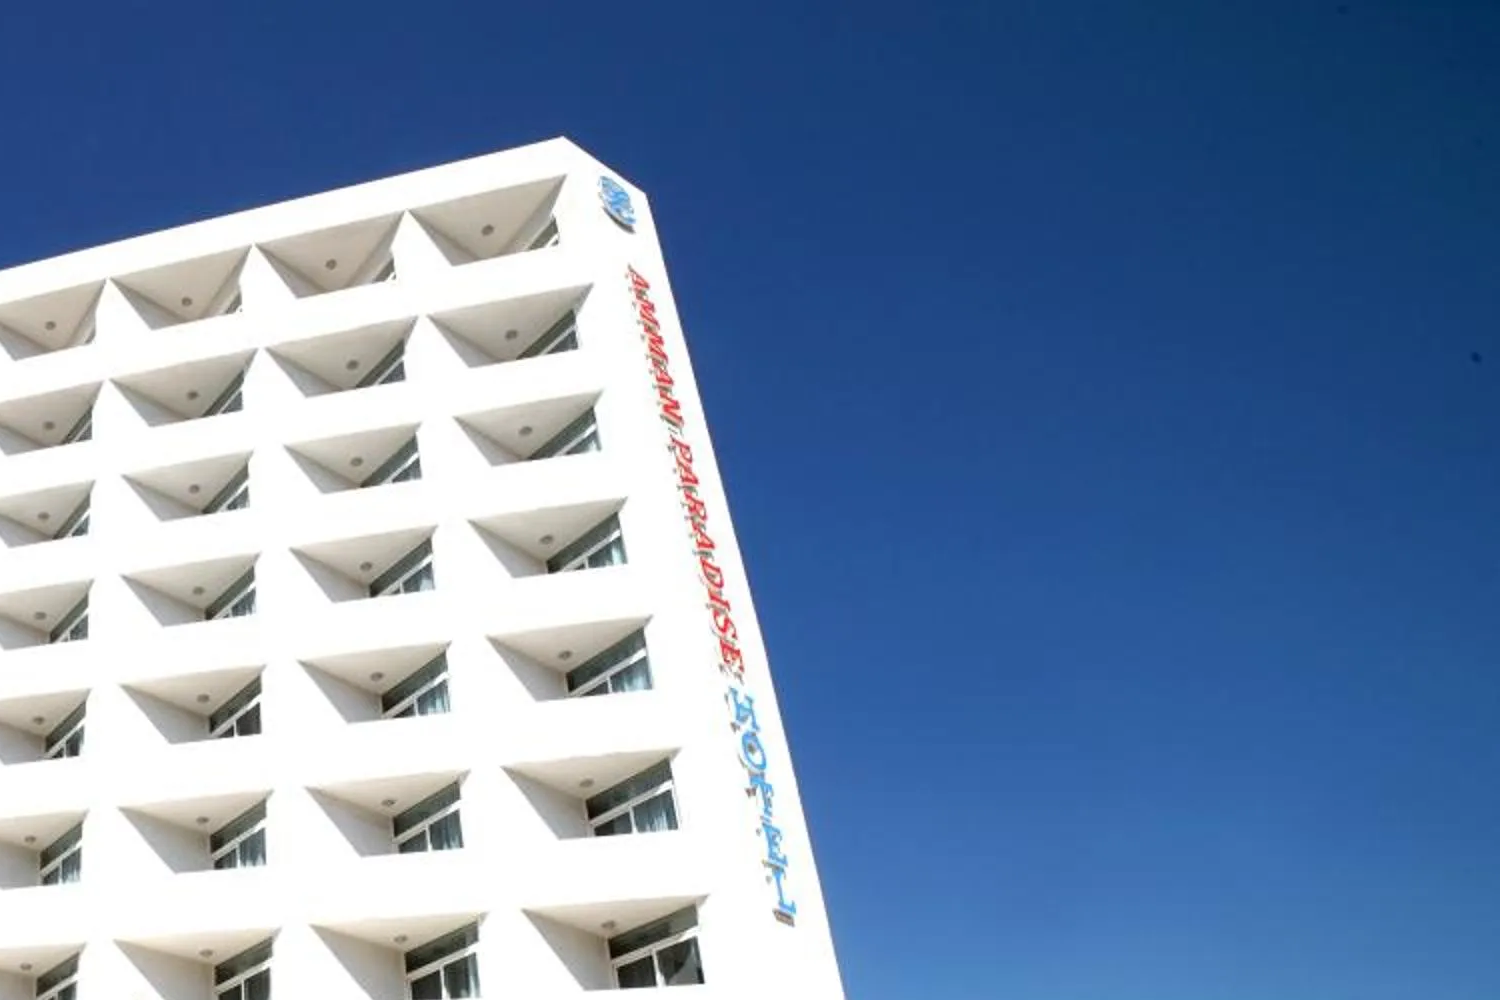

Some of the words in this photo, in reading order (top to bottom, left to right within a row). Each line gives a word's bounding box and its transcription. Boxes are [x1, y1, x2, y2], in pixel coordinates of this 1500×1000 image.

[628, 264, 686, 427] AMMAN
[670, 434, 745, 673] PARADISE
[729, 686, 797, 915] HOTEL
